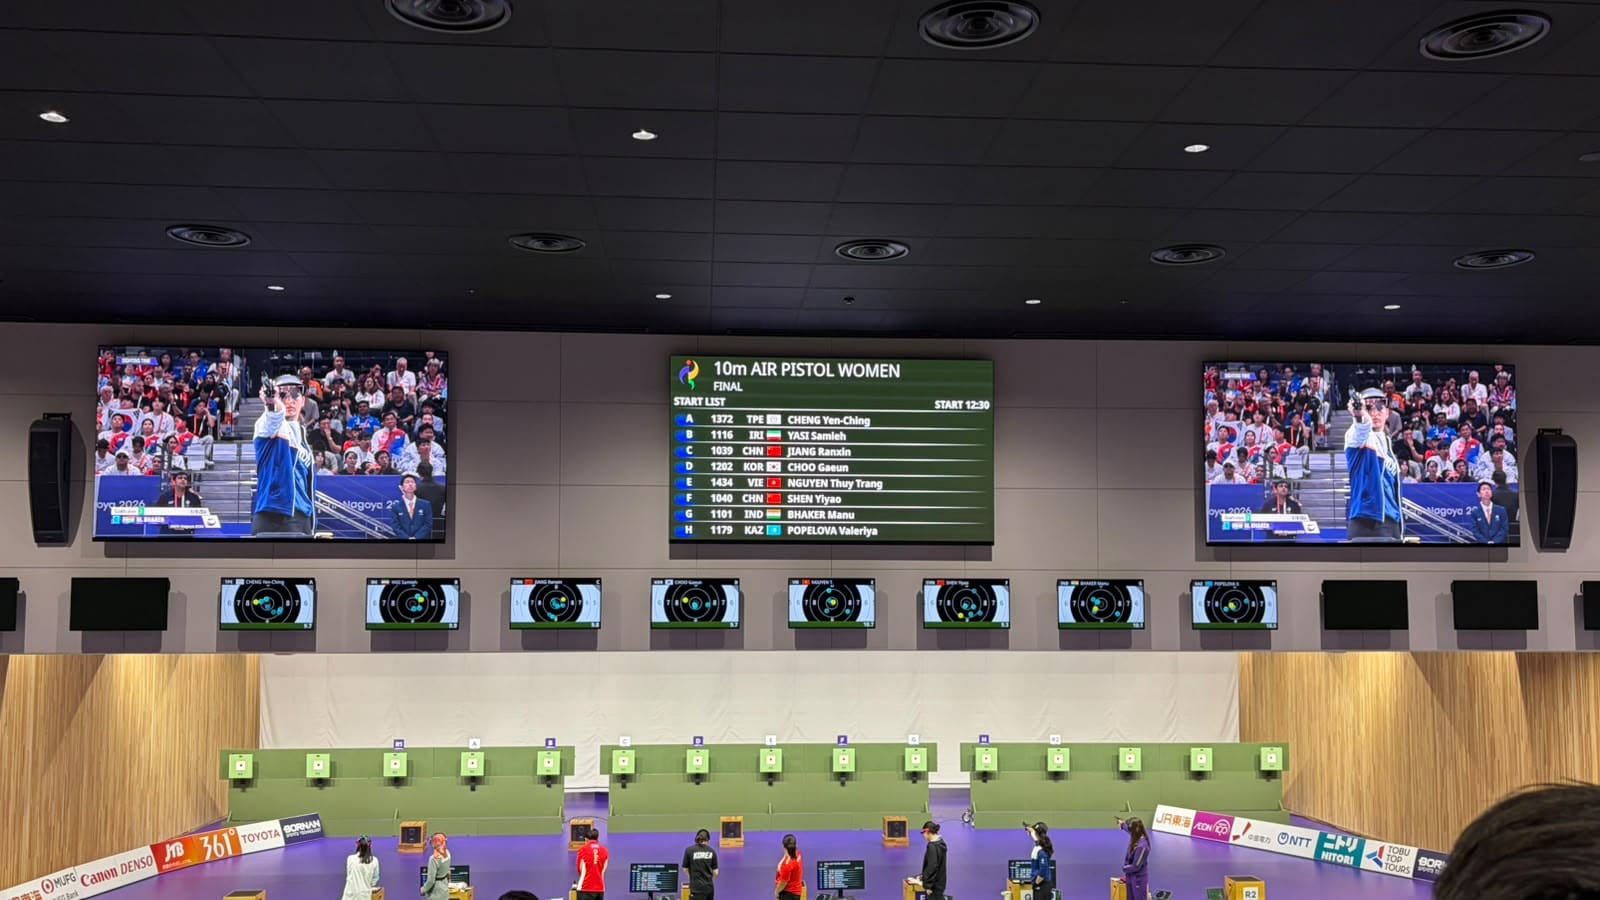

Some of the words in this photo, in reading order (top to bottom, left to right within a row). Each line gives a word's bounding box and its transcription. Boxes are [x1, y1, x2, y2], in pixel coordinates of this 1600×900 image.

[714, 362, 746, 376] 10m
[751, 363, 777, 376] AIR
[782, 363, 834, 377] PISTOL
[838, 364, 900, 378] WOMEN
[714, 382, 743, 391] FINAL
[674, 397, 702, 406] START
[705, 398, 725, 406] LIST
[935, 400, 963, 409] START
[965, 401, 990, 410] 12:30
[686, 415, 693, 423] A
[711, 415, 733, 424] 1372
[747, 415, 764, 424] TPE
[788, 416, 821, 425] CHENG
[822, 416, 870, 427] Yen-Ching
[686, 431, 693, 439] B
[711, 431, 733, 440] 1116
[750, 431, 764, 440] IRI
[788, 432, 809, 440] YASI
[811, 432, 846, 441] Samieh
[686, 447, 692, 455] C
[711, 447, 733, 455] 1039
[743, 447, 764, 455] CHN
[788, 448, 816, 458] JIANG
[818, 448, 851, 456] Ranxin
[686, 463, 693, 471] D
[711, 463, 733, 471] 1202
[744, 463, 764, 471] KOR
[788, 463, 815, 472] CHOO
[819, 464, 849, 472] Gaeun
[687, 478, 692, 486] E
[711, 478, 733, 487] 1434
[748, 479, 764, 487] VIE
[788, 479, 828, 488] NGUYEN
[830, 479, 854, 489] Thuy
[856, 480, 883, 490] Trang
[686, 494, 692, 502] F
[711, 494, 733, 502] 1040
[742, 494, 764, 503] CHN
[788, 495, 812, 503] SHEN
[814, 495, 841, 505] Yiyao
[686, 510, 693, 518] G
[711, 510, 732, 519] 1101
[744, 510, 763, 519] IND
[788, 511, 826, 520] BHAKER
[828, 511, 855, 520] Manu
[710, 526, 732, 535] 1179
[744, 526, 764, 535] KAZ
[788, 526, 837, 535] POPELOVA
[838, 526, 878, 537] Valeriya
[1156, 812, 1192, 828] JR東海
[283, 819, 320, 834] BORNAN
[241, 830, 280, 844] TOYOTA
[1290, 836, 1312, 848] NTT
[1323, 834, 1358, 852] ニトリ
[200, 829, 235, 861] 361°
[1388, 846, 1410, 856] TOBU
[165, 842, 184, 862] JTB
[1321, 851, 1354, 864] NITORI
[120, 856, 153, 874] DENSO
[1386, 855, 1402, 863] TOP
[1418, 857, 1446, 868] BOR
[1385, 863, 1410, 874] TOURS
[55, 873, 76, 888] MUFG
[81, 867, 118, 887] Canon
